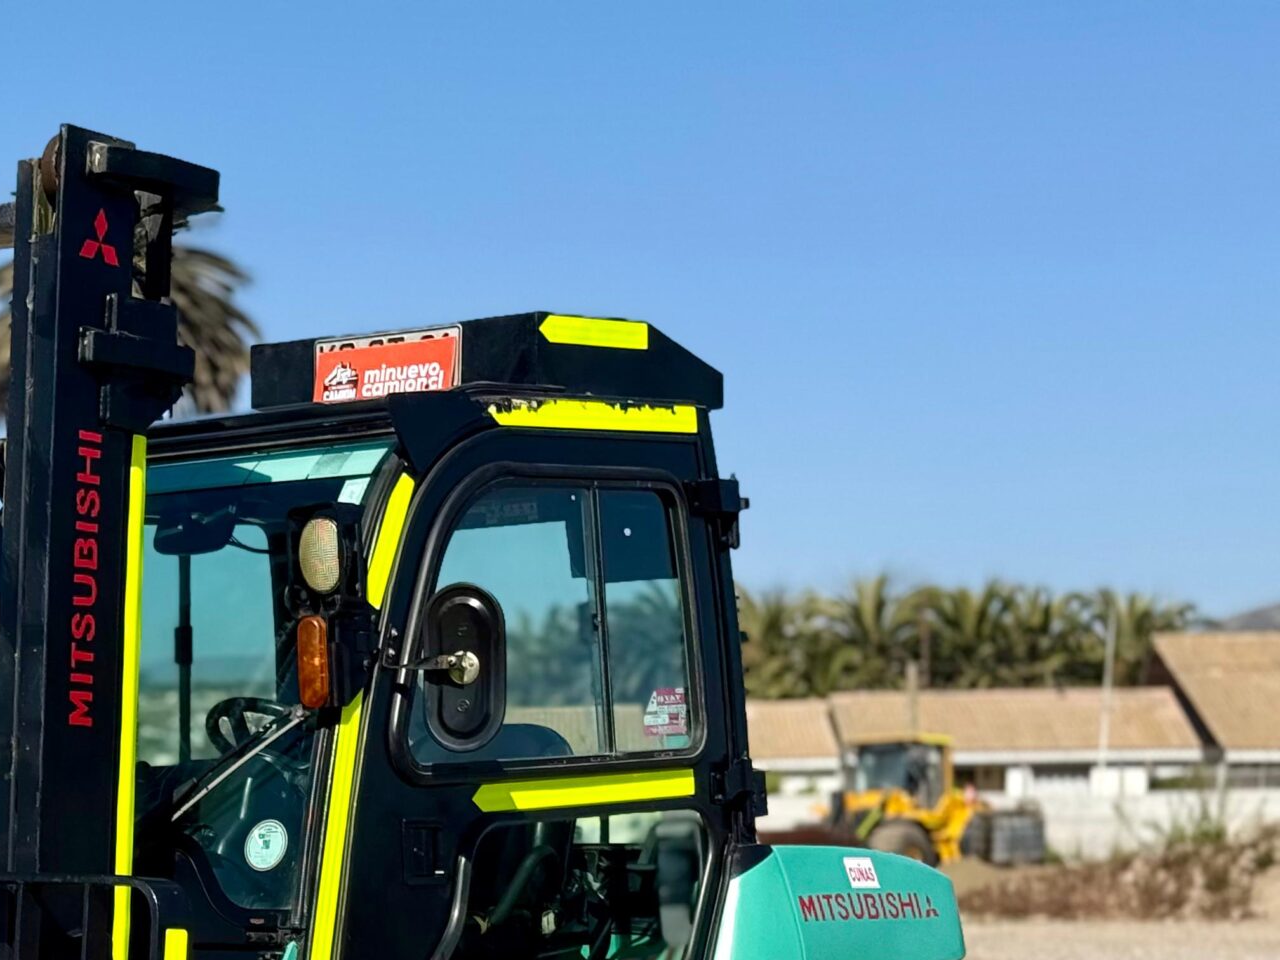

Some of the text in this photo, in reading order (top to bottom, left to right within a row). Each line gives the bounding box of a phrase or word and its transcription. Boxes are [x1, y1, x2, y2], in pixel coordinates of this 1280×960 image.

[364, 362, 440, 383] minuevo
[69, 429, 103, 727] MITSUBISHI
[798, 892, 922, 922] MITSUBISHI
